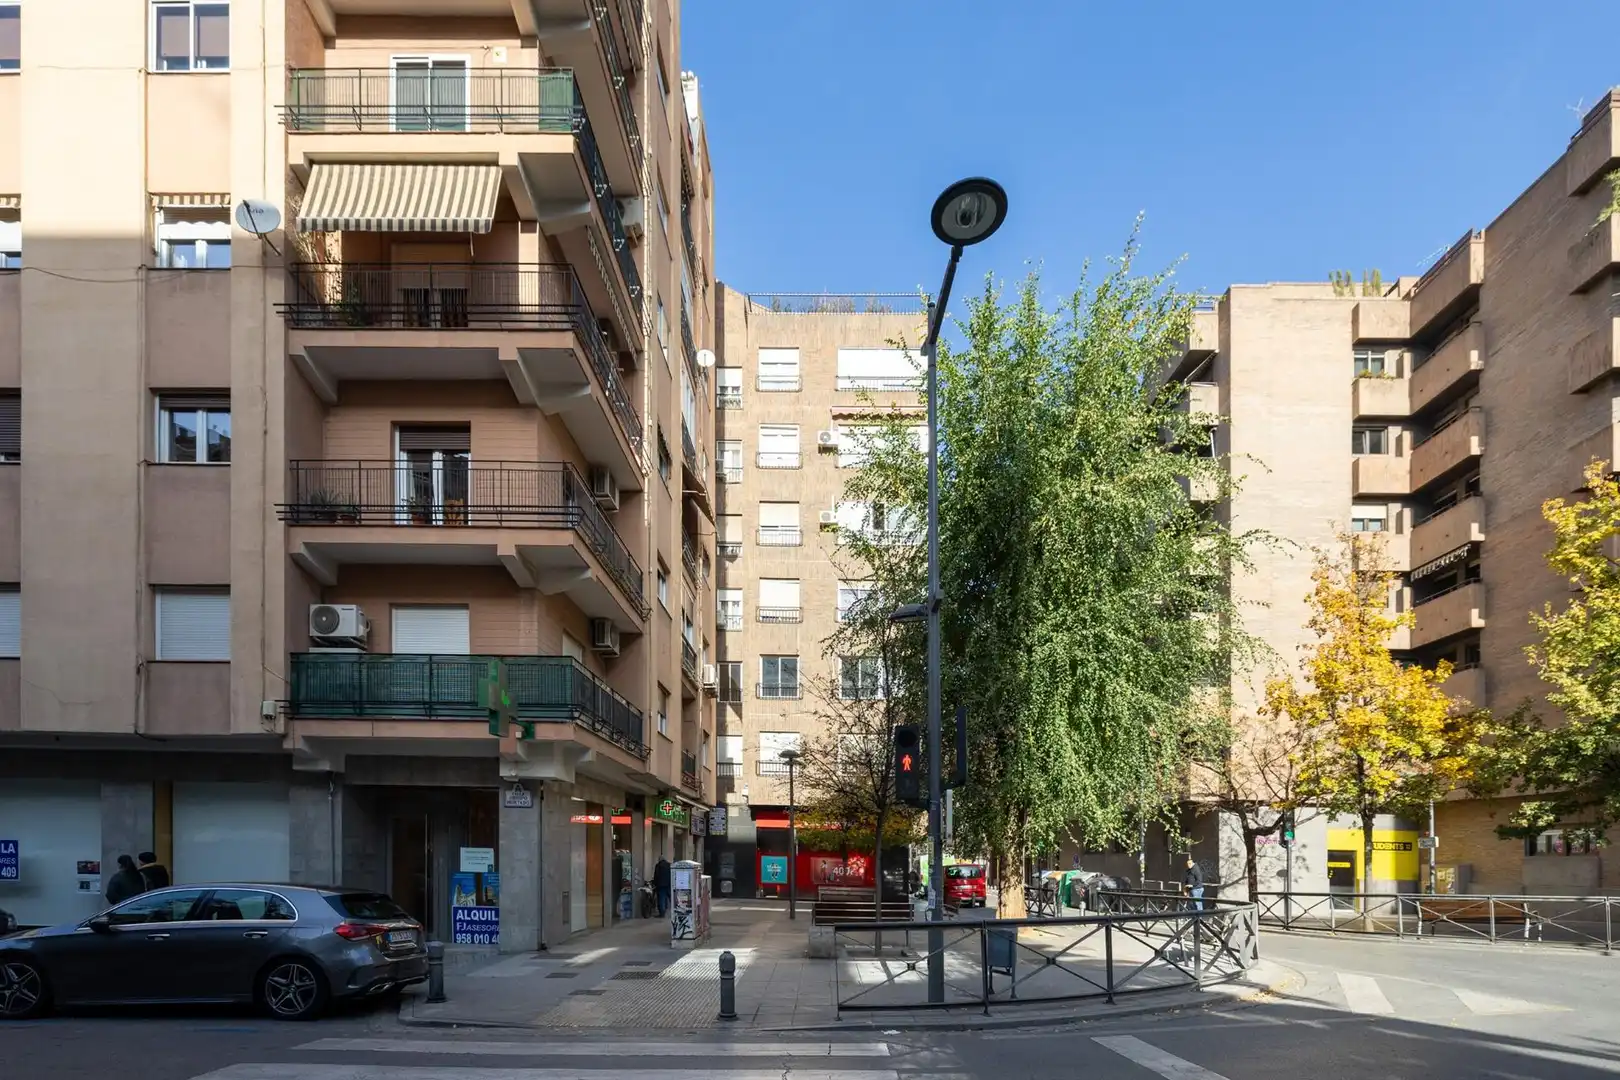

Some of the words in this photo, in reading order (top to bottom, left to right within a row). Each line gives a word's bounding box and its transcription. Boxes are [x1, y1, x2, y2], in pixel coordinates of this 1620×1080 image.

[1373, 842, 1404, 851] UDENTS
[1, 866, 17, 878] 409
[456, 933, 472, 944] 958
[473, 933, 490, 944] 010
